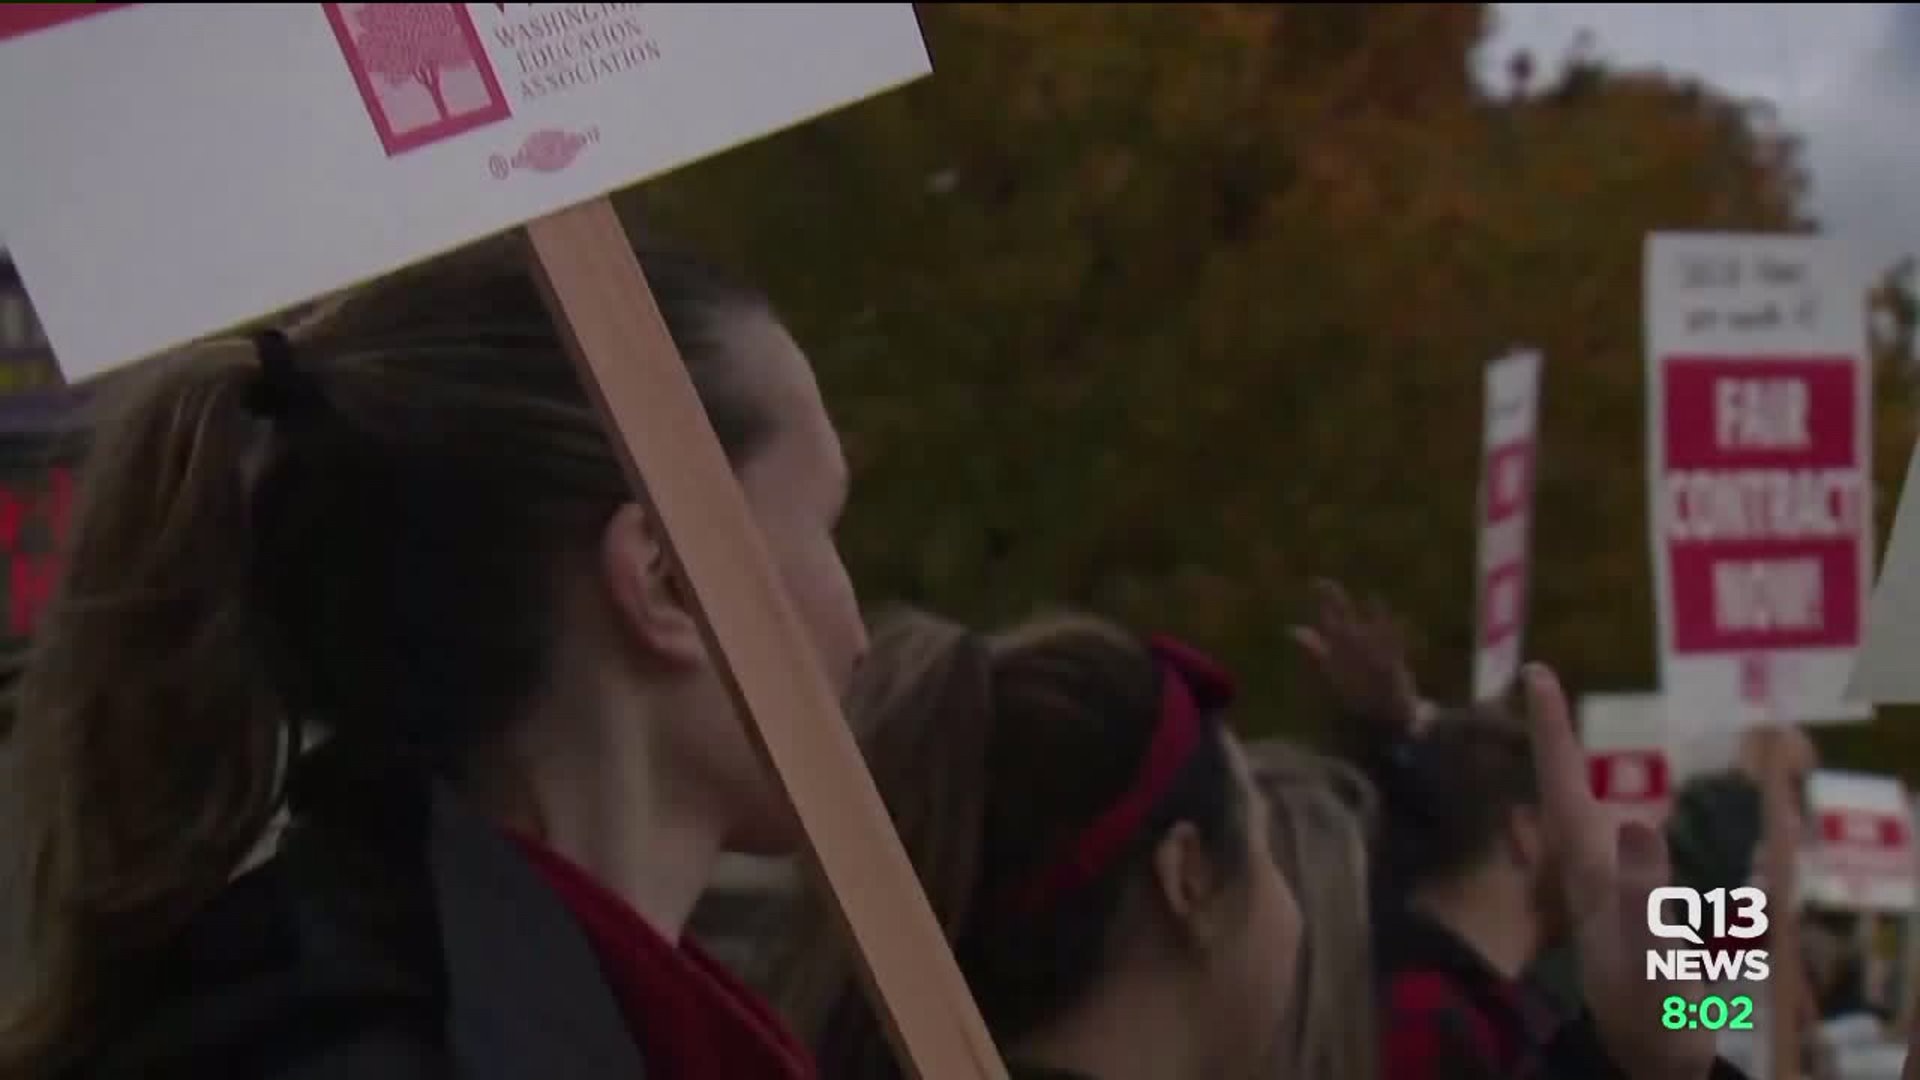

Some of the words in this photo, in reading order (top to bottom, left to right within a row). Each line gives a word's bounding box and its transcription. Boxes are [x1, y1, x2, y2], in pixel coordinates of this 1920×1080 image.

[516, 19, 642, 72] EDUCATION
[521, 38, 661, 98] ASSOCIATION
[1715, 377, 1812, 447] FAIR
[1668, 469, 1863, 538] CONTRACT
[1713, 557, 1823, 631] NOW!
